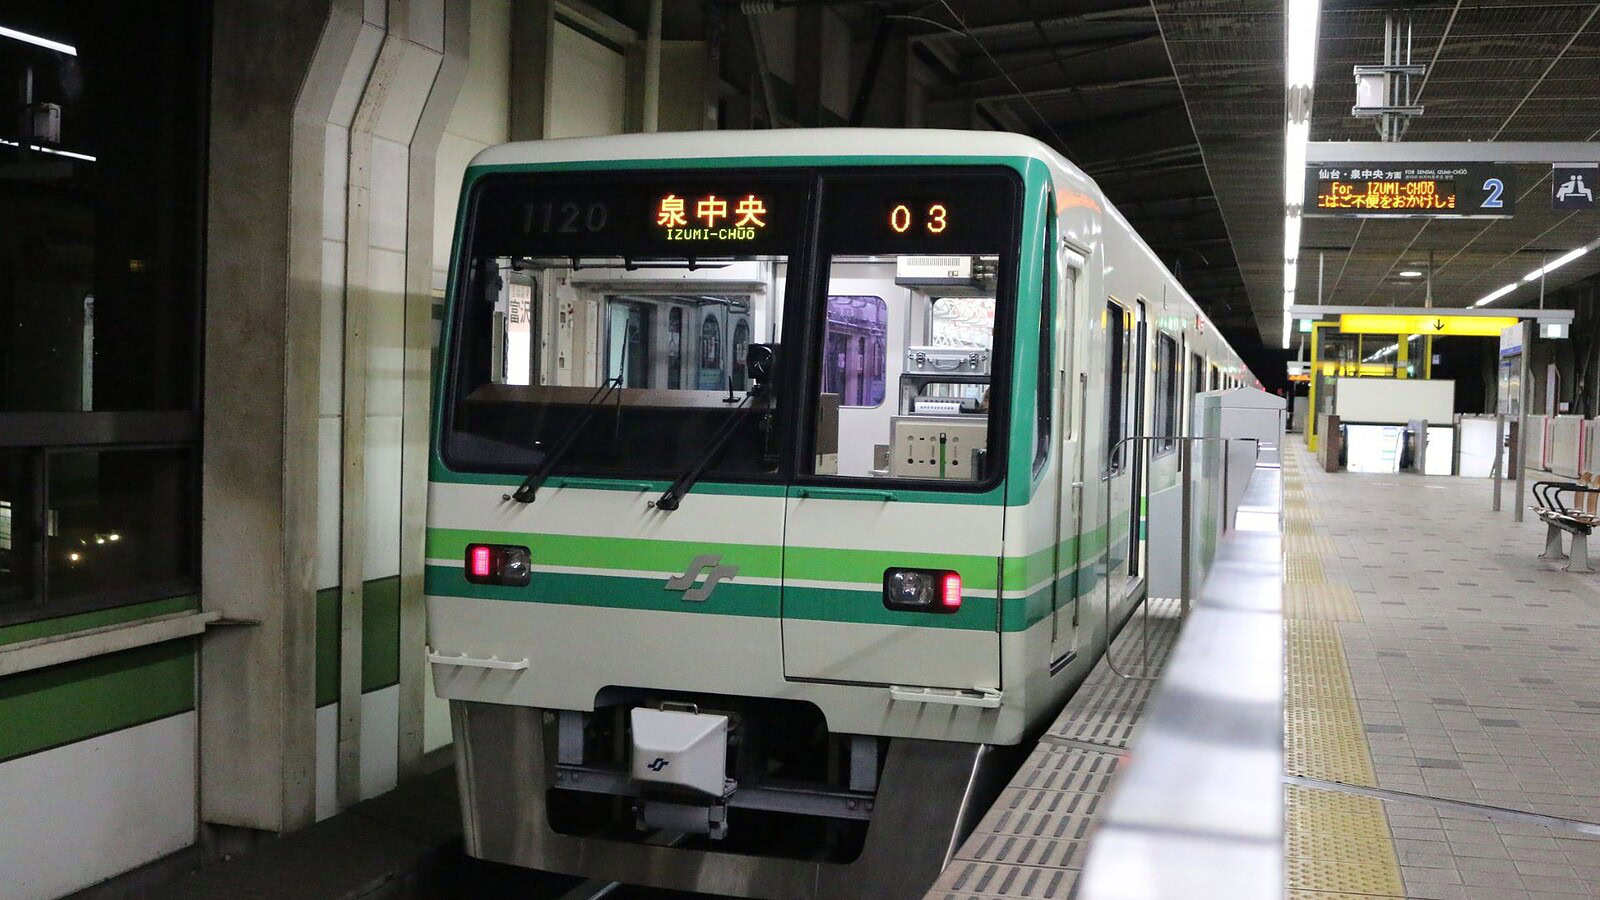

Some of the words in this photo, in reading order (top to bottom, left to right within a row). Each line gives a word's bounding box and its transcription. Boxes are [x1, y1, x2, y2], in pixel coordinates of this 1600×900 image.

[1332, 182, 1353, 194] For
[1481, 178, 1503, 208] 2
[523, 201, 607, 233] 1120
[657, 195, 766, 228] 泉中央
